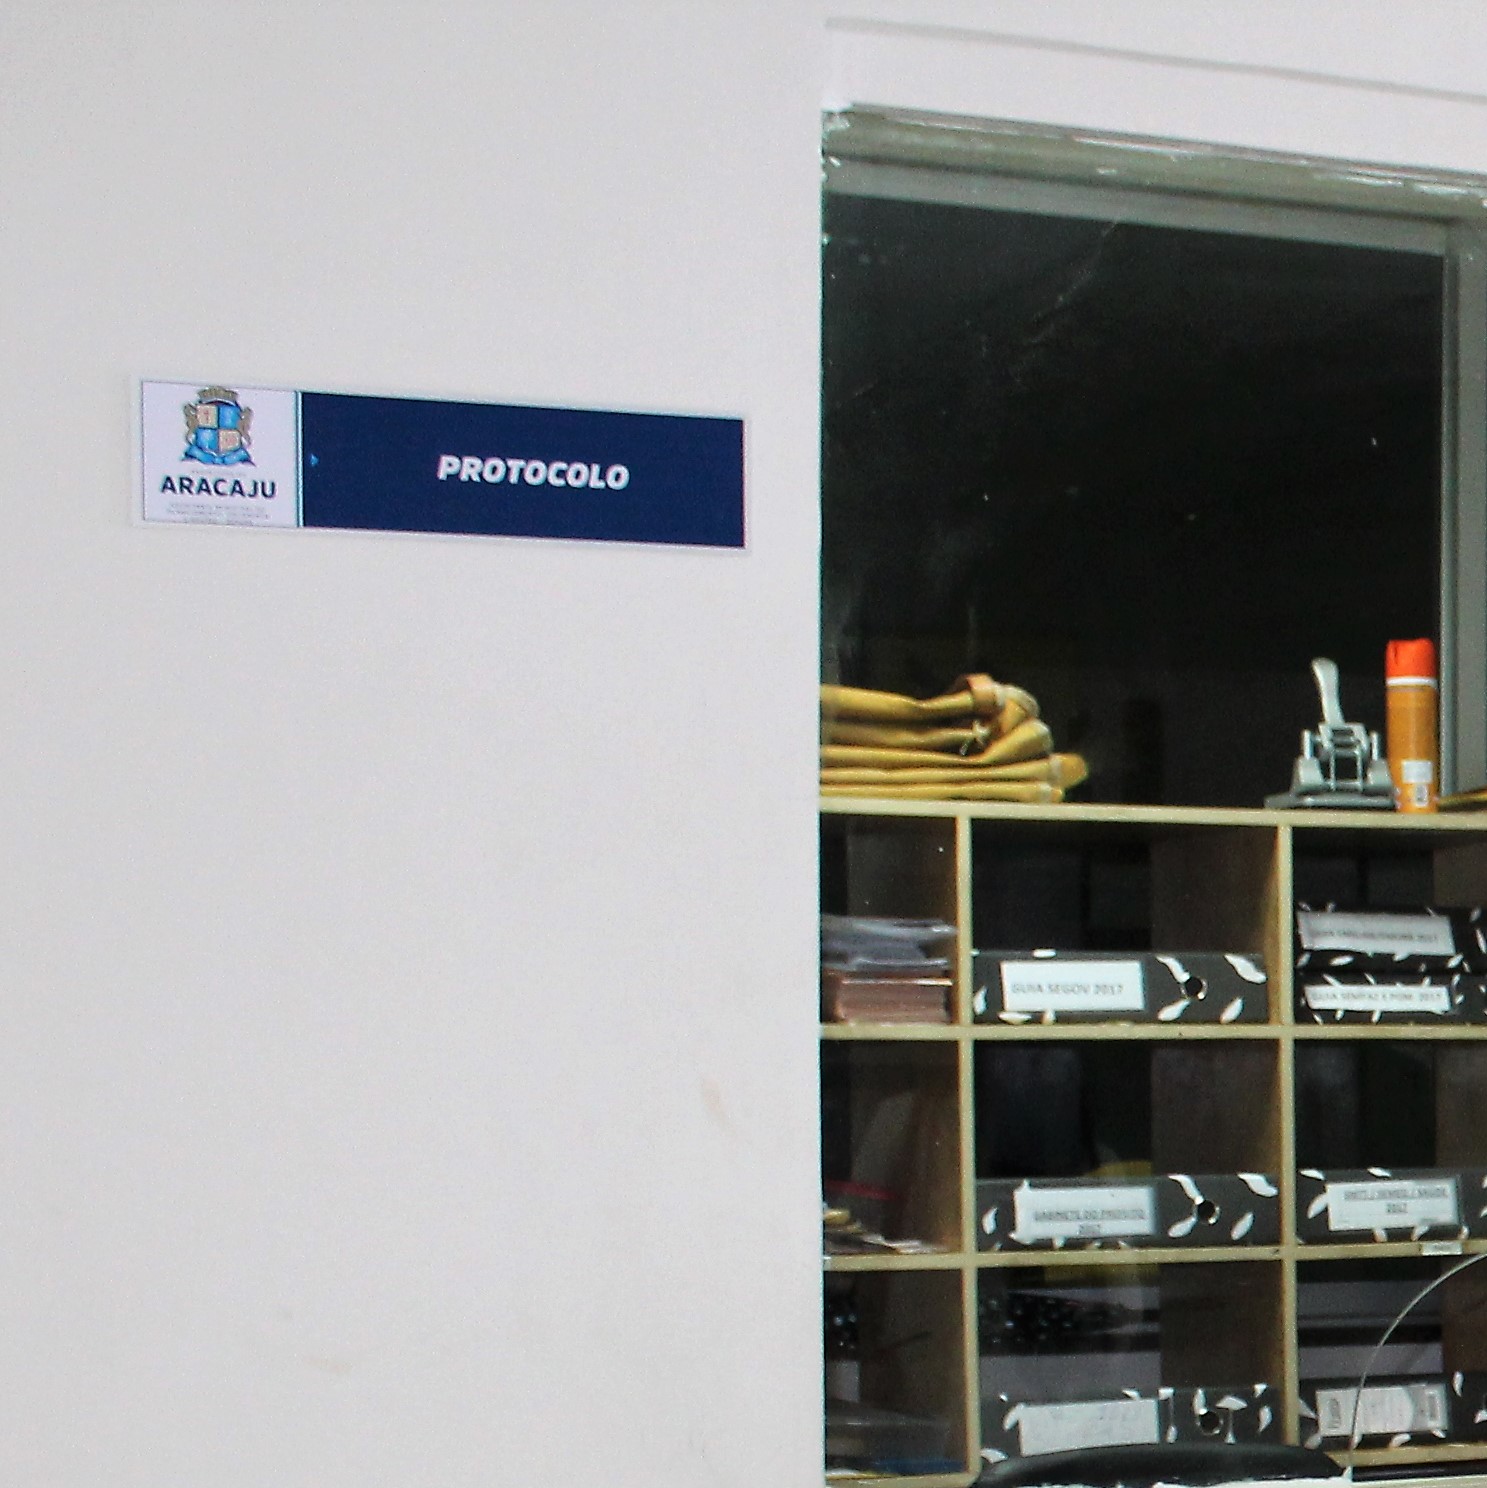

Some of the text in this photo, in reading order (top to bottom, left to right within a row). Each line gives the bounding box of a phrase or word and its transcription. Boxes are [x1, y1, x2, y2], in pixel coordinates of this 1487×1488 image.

[438, 454, 631, 490] PROTOCOLO
[160, 475, 277, 498] ARACAJU
[1011, 982, 1044, 994] GUIA
